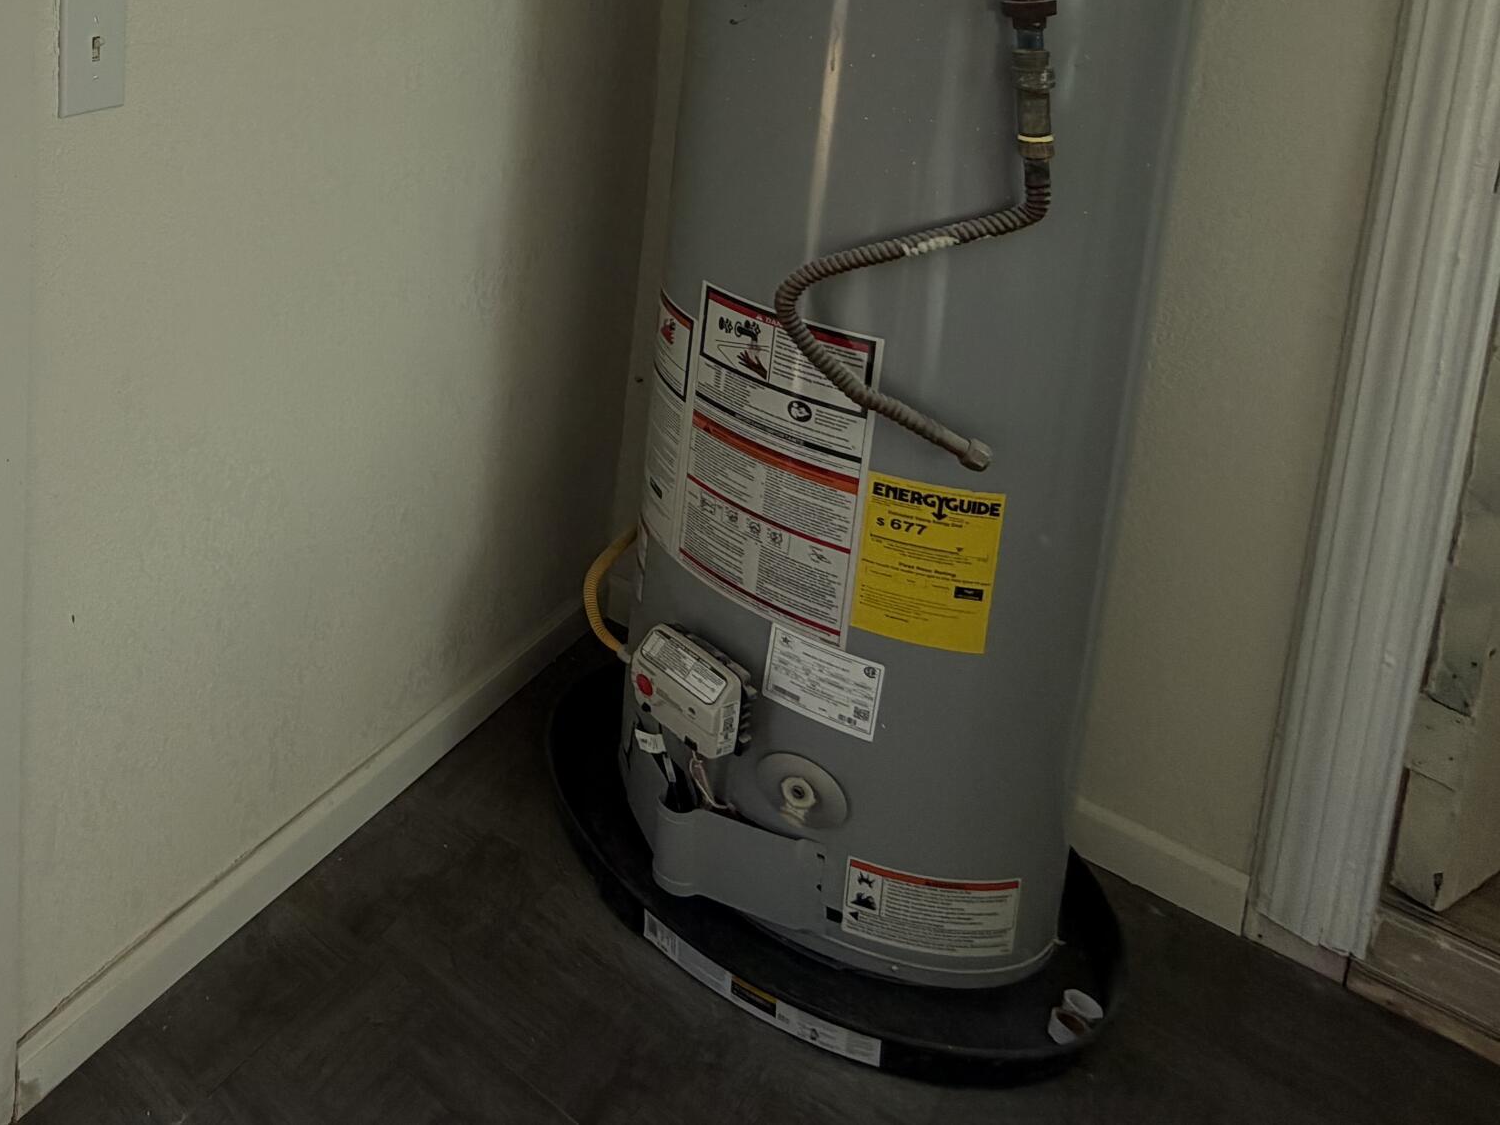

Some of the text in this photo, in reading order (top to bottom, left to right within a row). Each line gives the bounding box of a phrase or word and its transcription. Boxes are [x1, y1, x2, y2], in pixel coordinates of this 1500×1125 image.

[872, 481, 1002, 520] ENERGYGUIDE
[876, 517, 928, 535] $ 677
